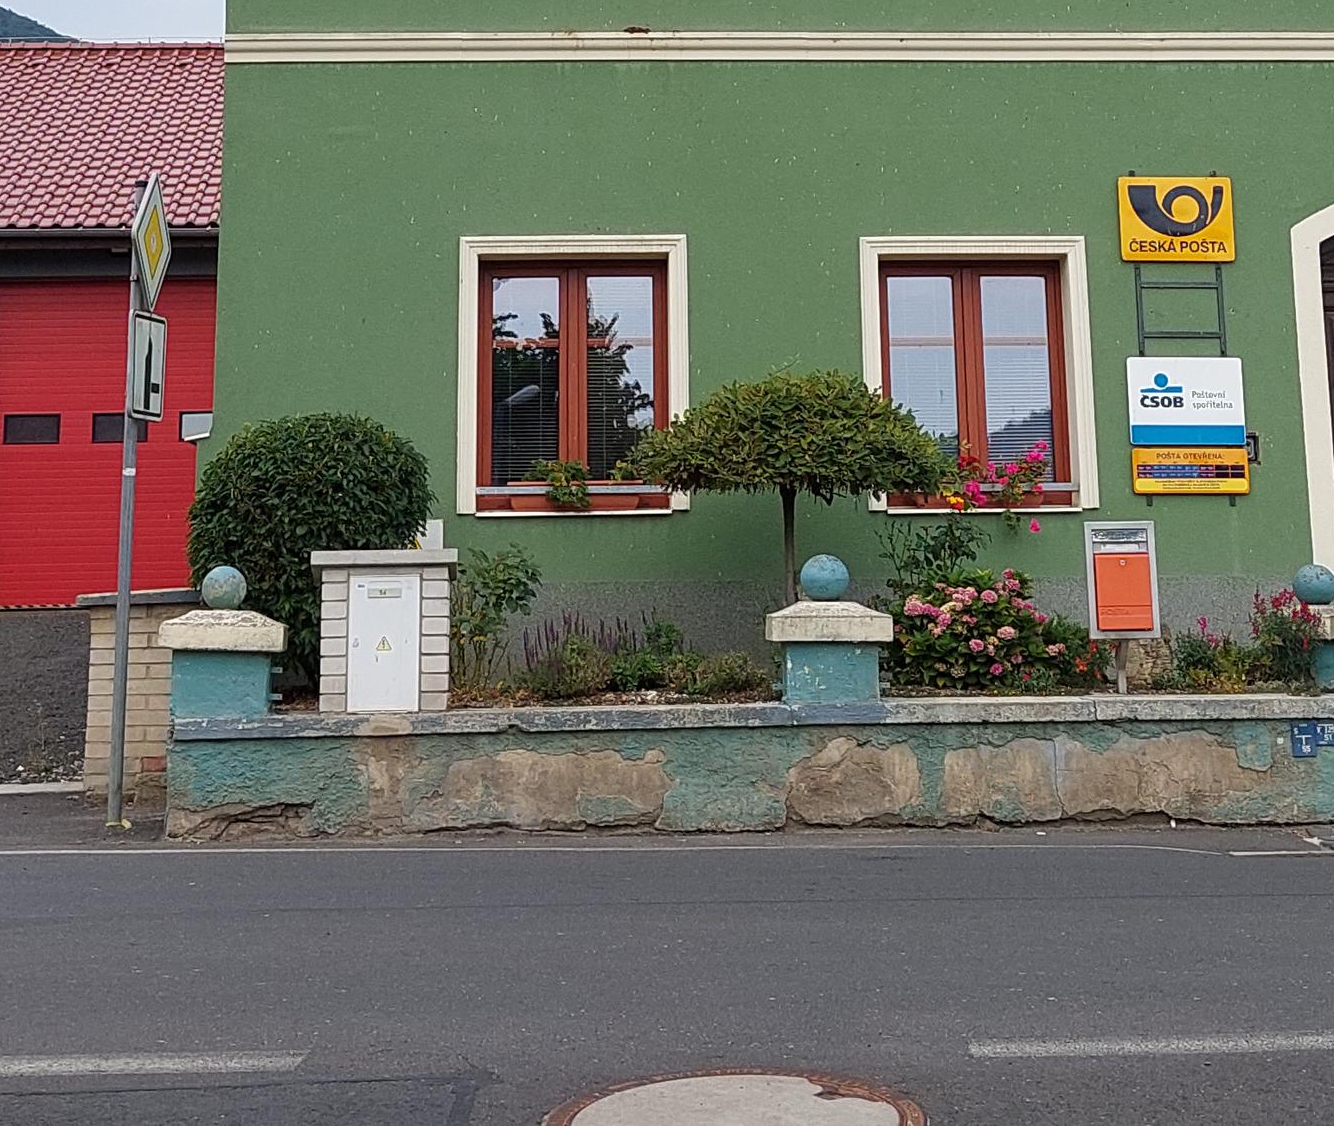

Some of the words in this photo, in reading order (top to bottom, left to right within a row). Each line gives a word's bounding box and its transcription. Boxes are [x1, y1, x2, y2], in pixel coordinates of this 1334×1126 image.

[1129, 238, 1177, 253] ČESKÁ
[1180, 238, 1227, 253] POŠTA
[1140, 394, 1184, 408] ČSOB
[1156, 451, 1180, 460] POŠTA
